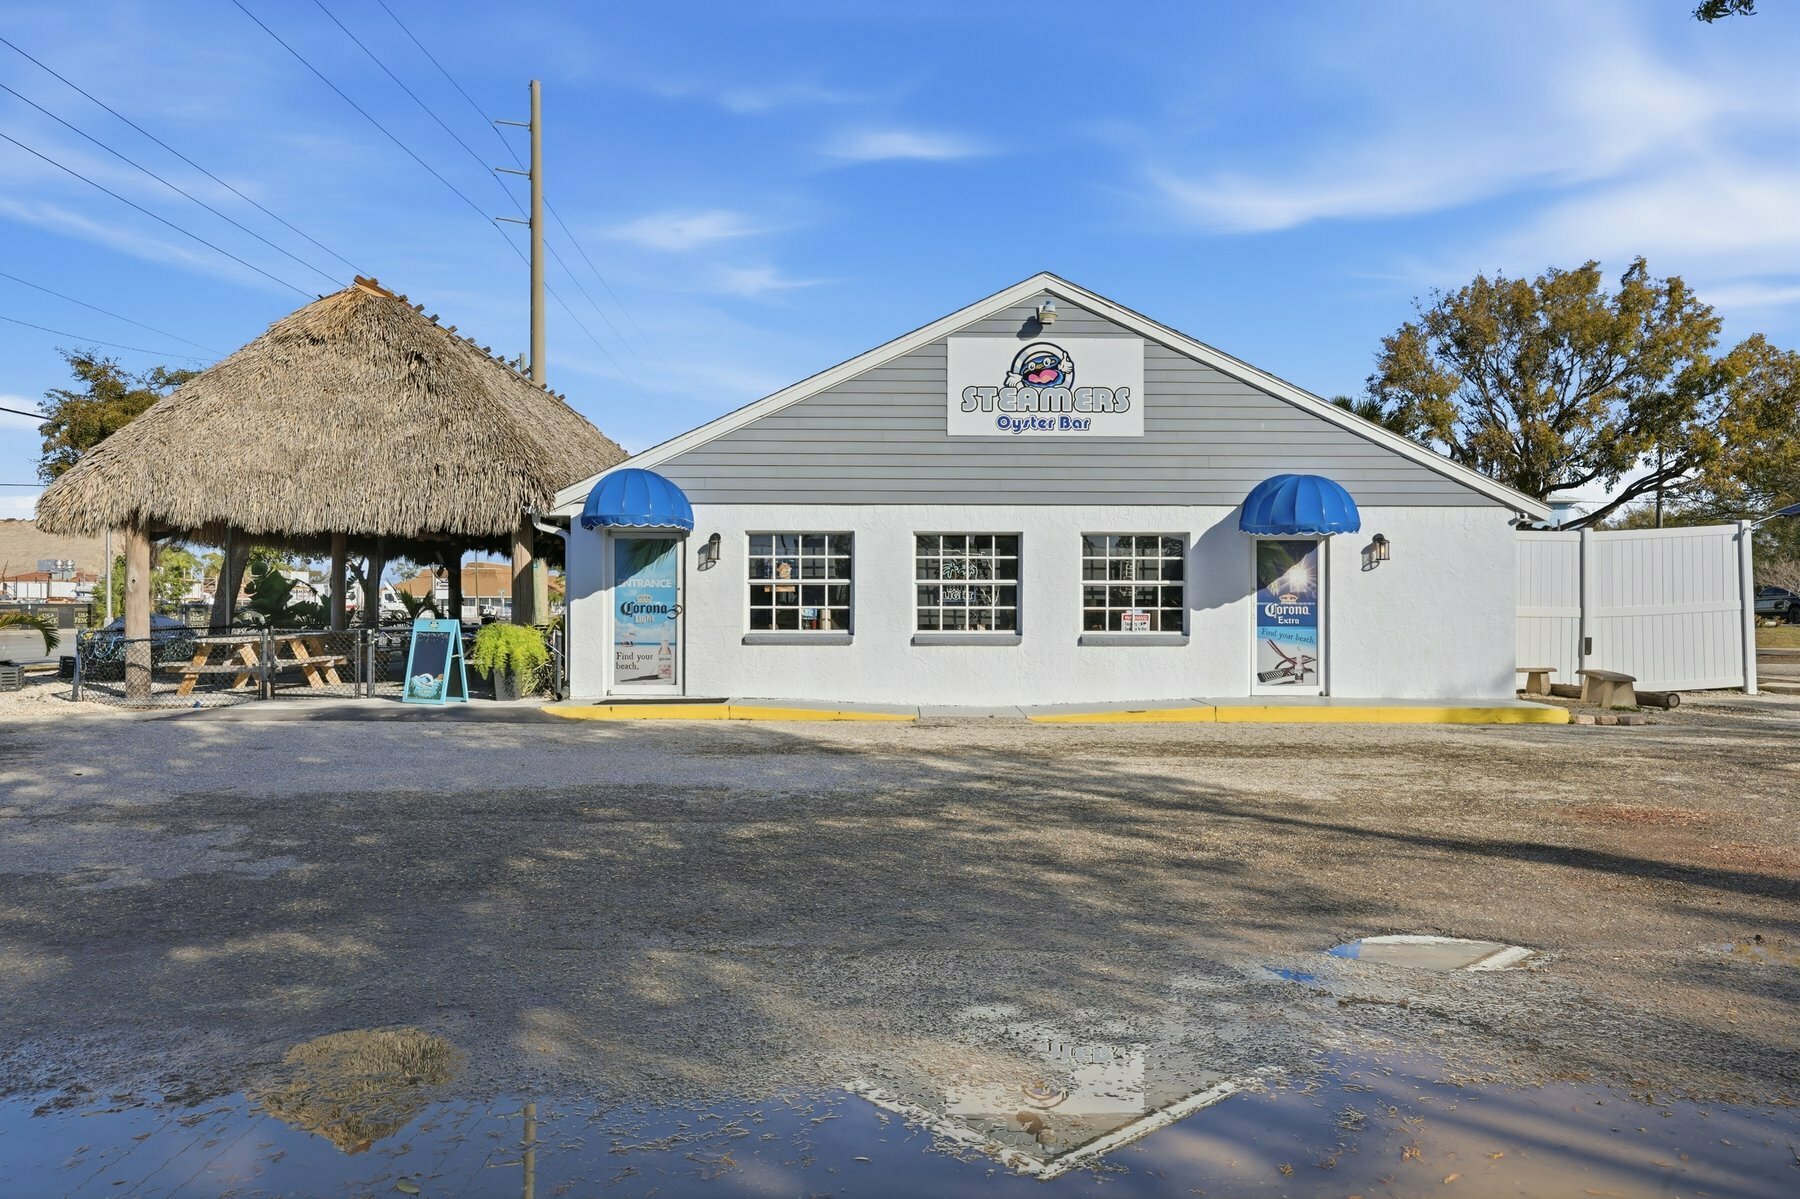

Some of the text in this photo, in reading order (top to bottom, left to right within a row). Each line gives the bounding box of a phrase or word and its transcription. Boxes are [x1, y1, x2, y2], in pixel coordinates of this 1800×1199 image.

[961, 386, 1131, 413] STEAMERS
[996, 414, 1091, 434] Oyster Bar
[618, 578, 672, 588] ENTRANCE
[620, 601, 668, 617] Corona
[1264, 602, 1310, 618] Corona
[1278, 616, 1300, 624] Extra
[1261, 627, 1316, 644] Find your beach.
[616, 651, 634, 660] Find
[637, 654, 654, 663] your
[616, 661, 639, 670] beach.
